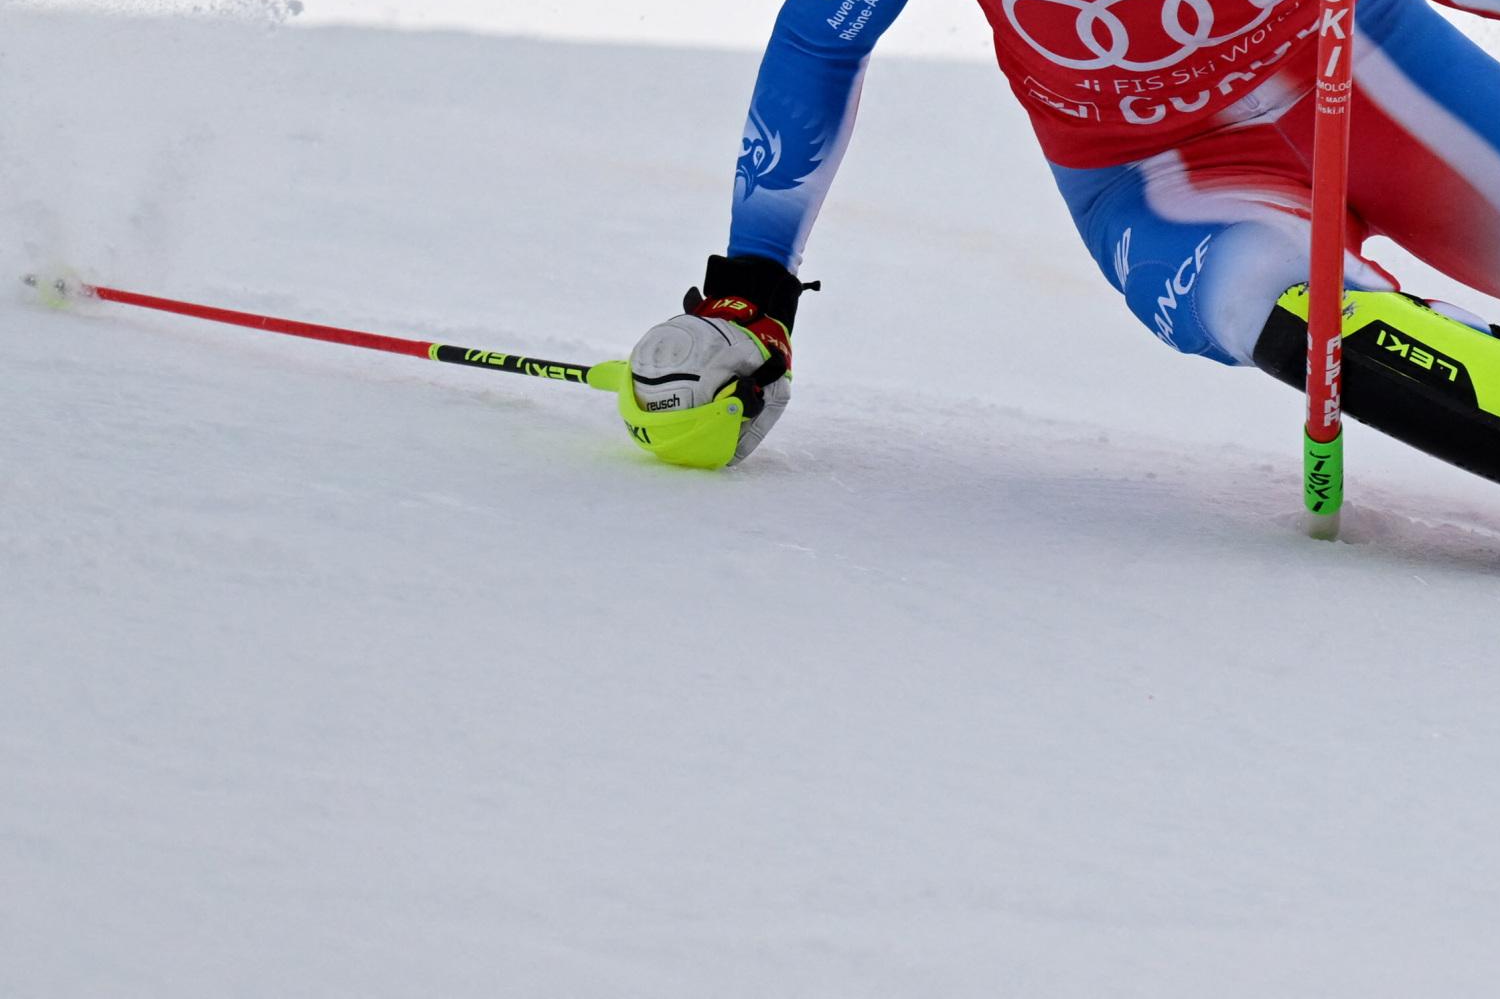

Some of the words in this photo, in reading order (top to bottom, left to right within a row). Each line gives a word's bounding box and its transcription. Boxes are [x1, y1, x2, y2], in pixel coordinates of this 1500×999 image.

[1113, 75, 1164, 95] FIS
[1171, 59, 1216, 87] Ski
[1376, 329, 1458, 382] LEKI
[646, 393, 681, 412] reusch
